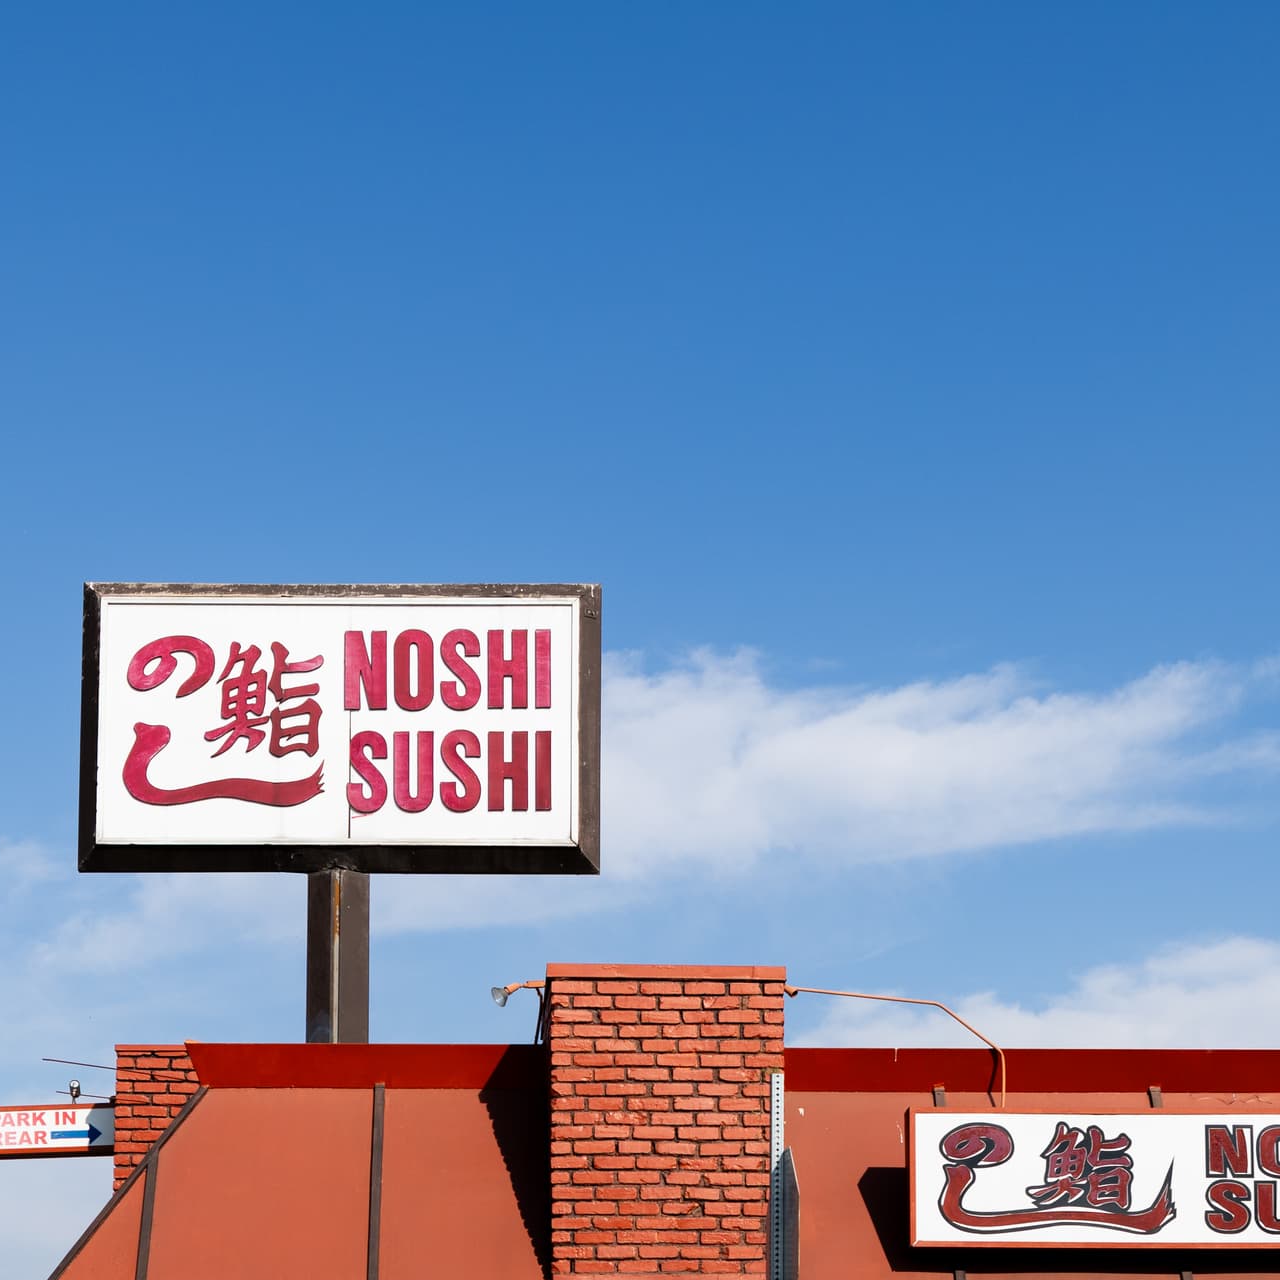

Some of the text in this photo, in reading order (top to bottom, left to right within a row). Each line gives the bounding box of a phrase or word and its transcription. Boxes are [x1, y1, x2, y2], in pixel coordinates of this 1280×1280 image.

[343, 628, 552, 711] NOSHI
[346, 728, 552, 813] SUSHI
[55, 1111, 77, 1126] IN
